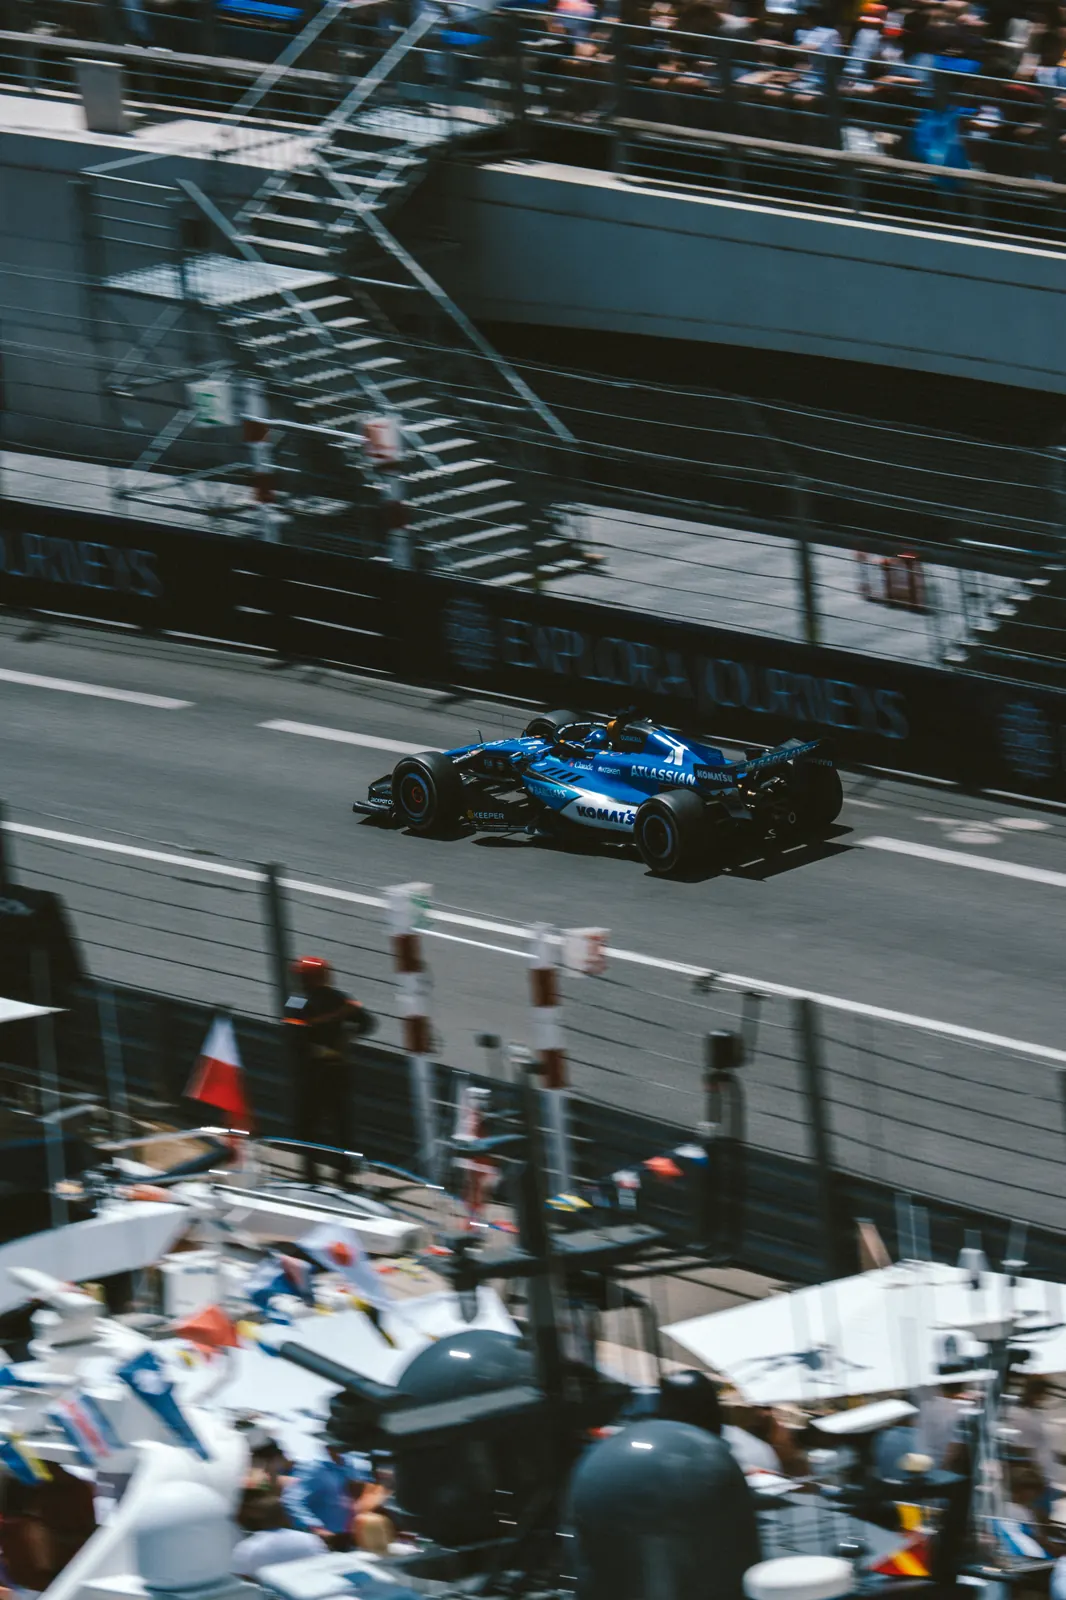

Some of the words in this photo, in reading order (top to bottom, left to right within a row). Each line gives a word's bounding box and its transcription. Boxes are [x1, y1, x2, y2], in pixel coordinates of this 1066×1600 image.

[574, 761, 594, 771] Claude
[631, 765, 696, 786] ATLASSIAN
[697, 770, 733, 783] KOMATSU
[534, 786, 567, 799] BARCLAYS
[473, 811, 505, 820] KEEPER
[576, 805, 636, 826] KOMATS
